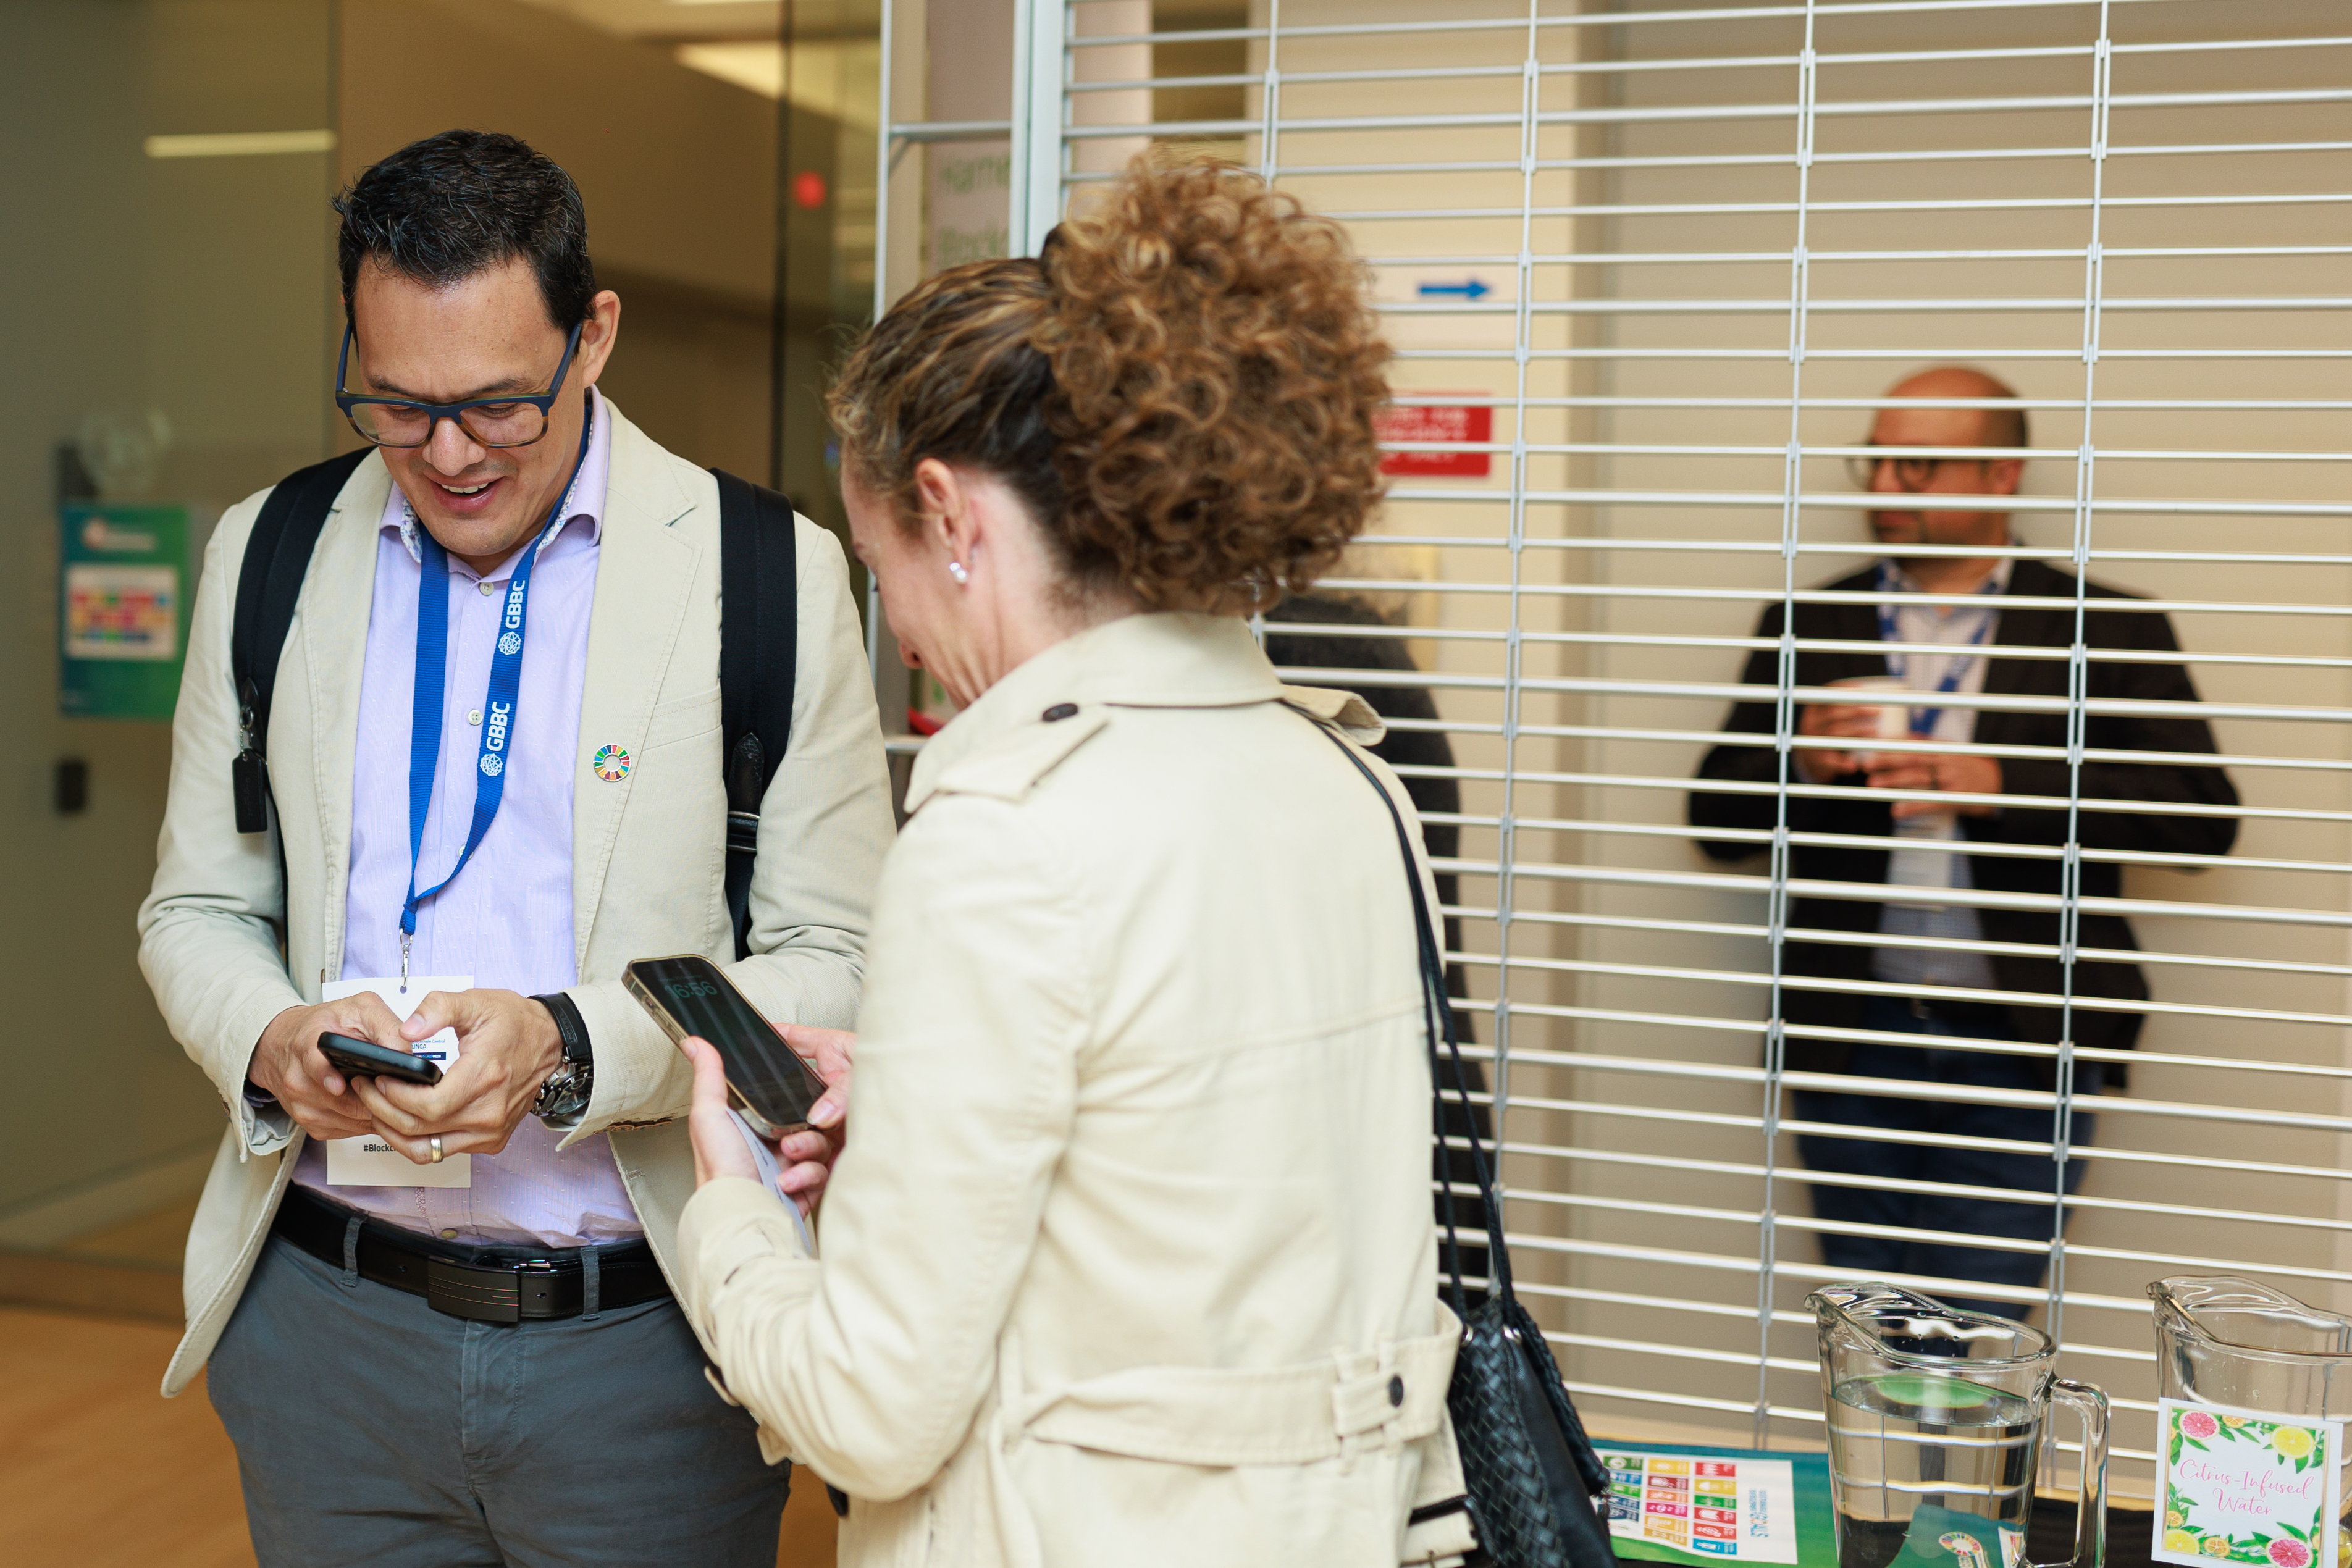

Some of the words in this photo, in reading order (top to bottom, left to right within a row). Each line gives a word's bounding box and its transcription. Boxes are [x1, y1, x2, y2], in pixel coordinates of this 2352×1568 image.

[505, 580, 526, 629] GBBC
[486, 701, 510, 752] GBBC
[664, 981, 718, 999] 16:56
[363, 1144, 396, 1152] #Blockc
[2180, 1459, 2314, 1499] Citrus-Infused
[2212, 1487, 2273, 1515] Water
